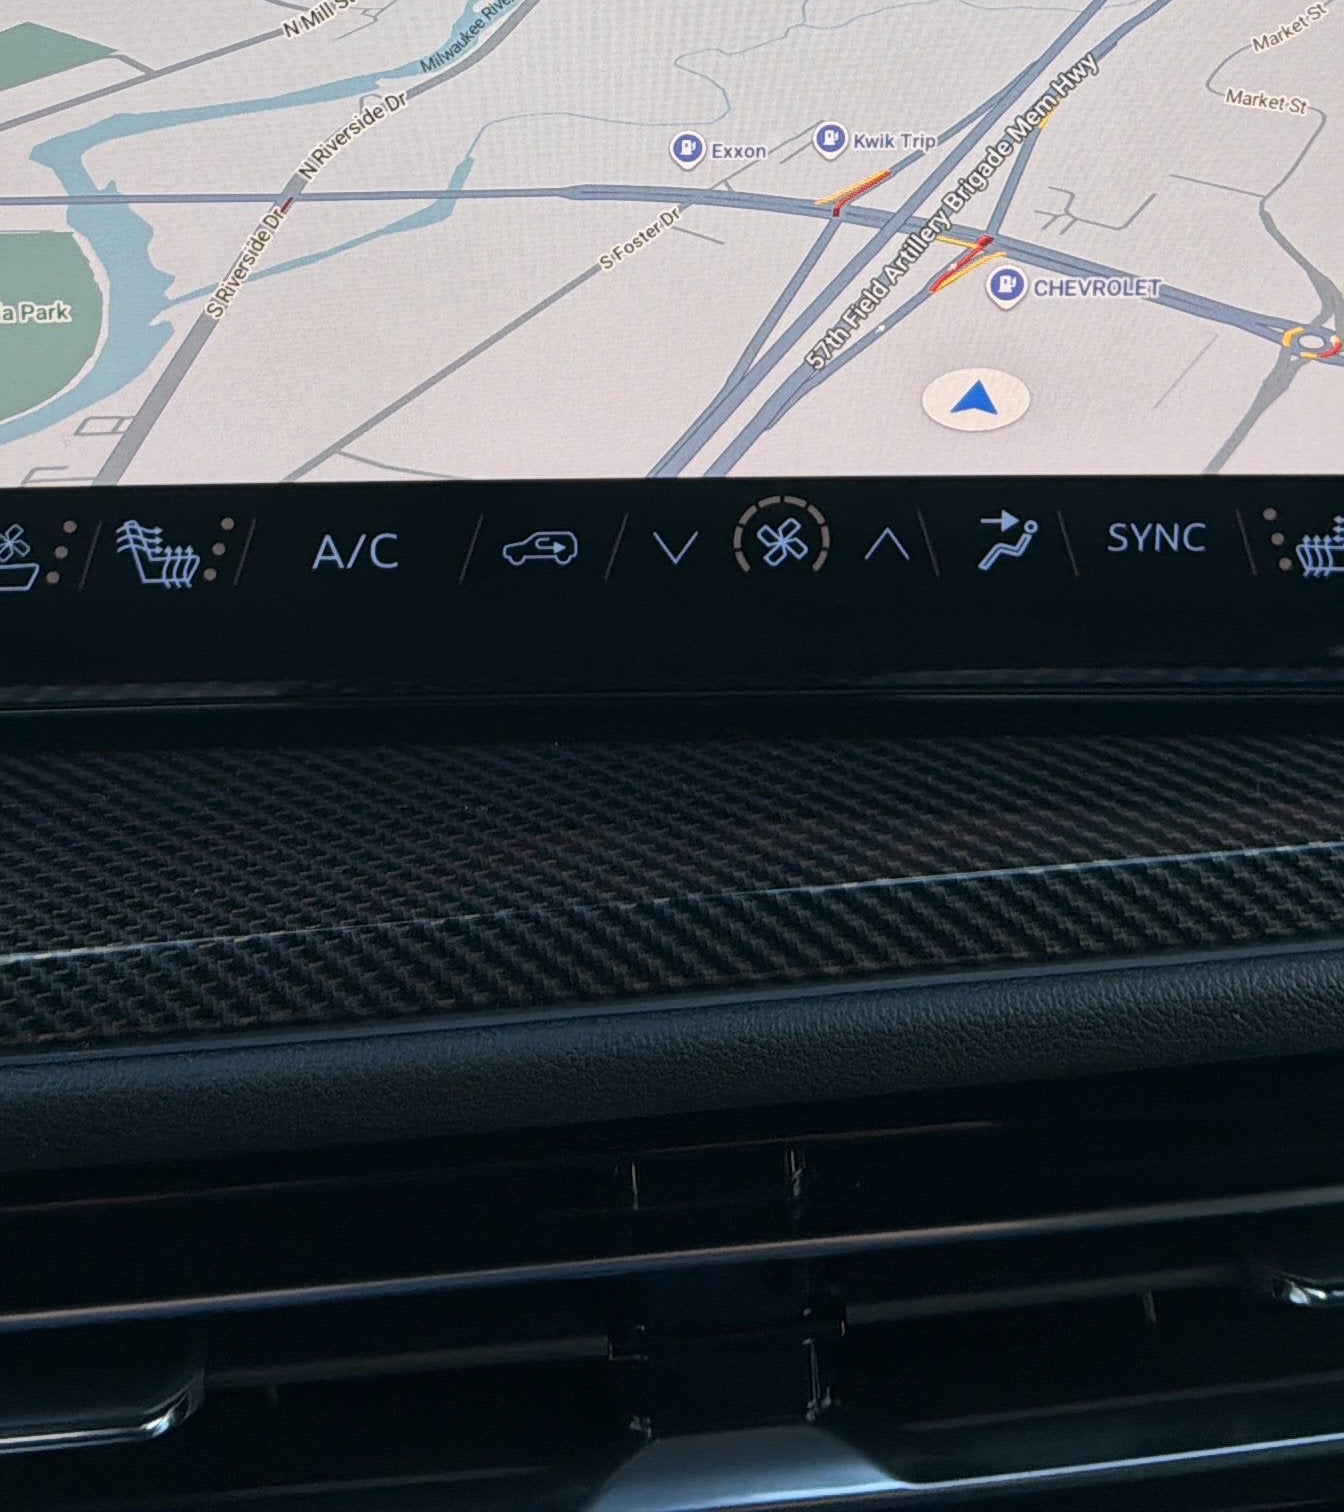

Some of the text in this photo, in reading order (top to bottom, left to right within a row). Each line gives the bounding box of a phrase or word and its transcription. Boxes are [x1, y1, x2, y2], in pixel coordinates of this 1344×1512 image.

[283, 22, 299, 39] N
[300, 3, 334, 32] Mill
[1252, 3, 1328, 53] Market St
[420, 20, 485, 74] Milwaukee
[1226, 89, 1307, 115] Market St
[299, 90, 408, 181] N Riverside Dr
[712, 144, 766, 159] Exxon
[854, 133, 936, 152] Kwik Trip
[805, 52, 1100, 371] 57th Field Artillery Brigade Mem Hwy
[599, 206, 681, 271] S Foster Dr
[207, 209, 284, 319] S Riverside Dr
[1035, 278, 1161, 297] CHEVROLET
[21, 302, 71, 322] Park
[312, 533, 399, 571] A/C
[1107, 522, 1206, 554] SYNC
